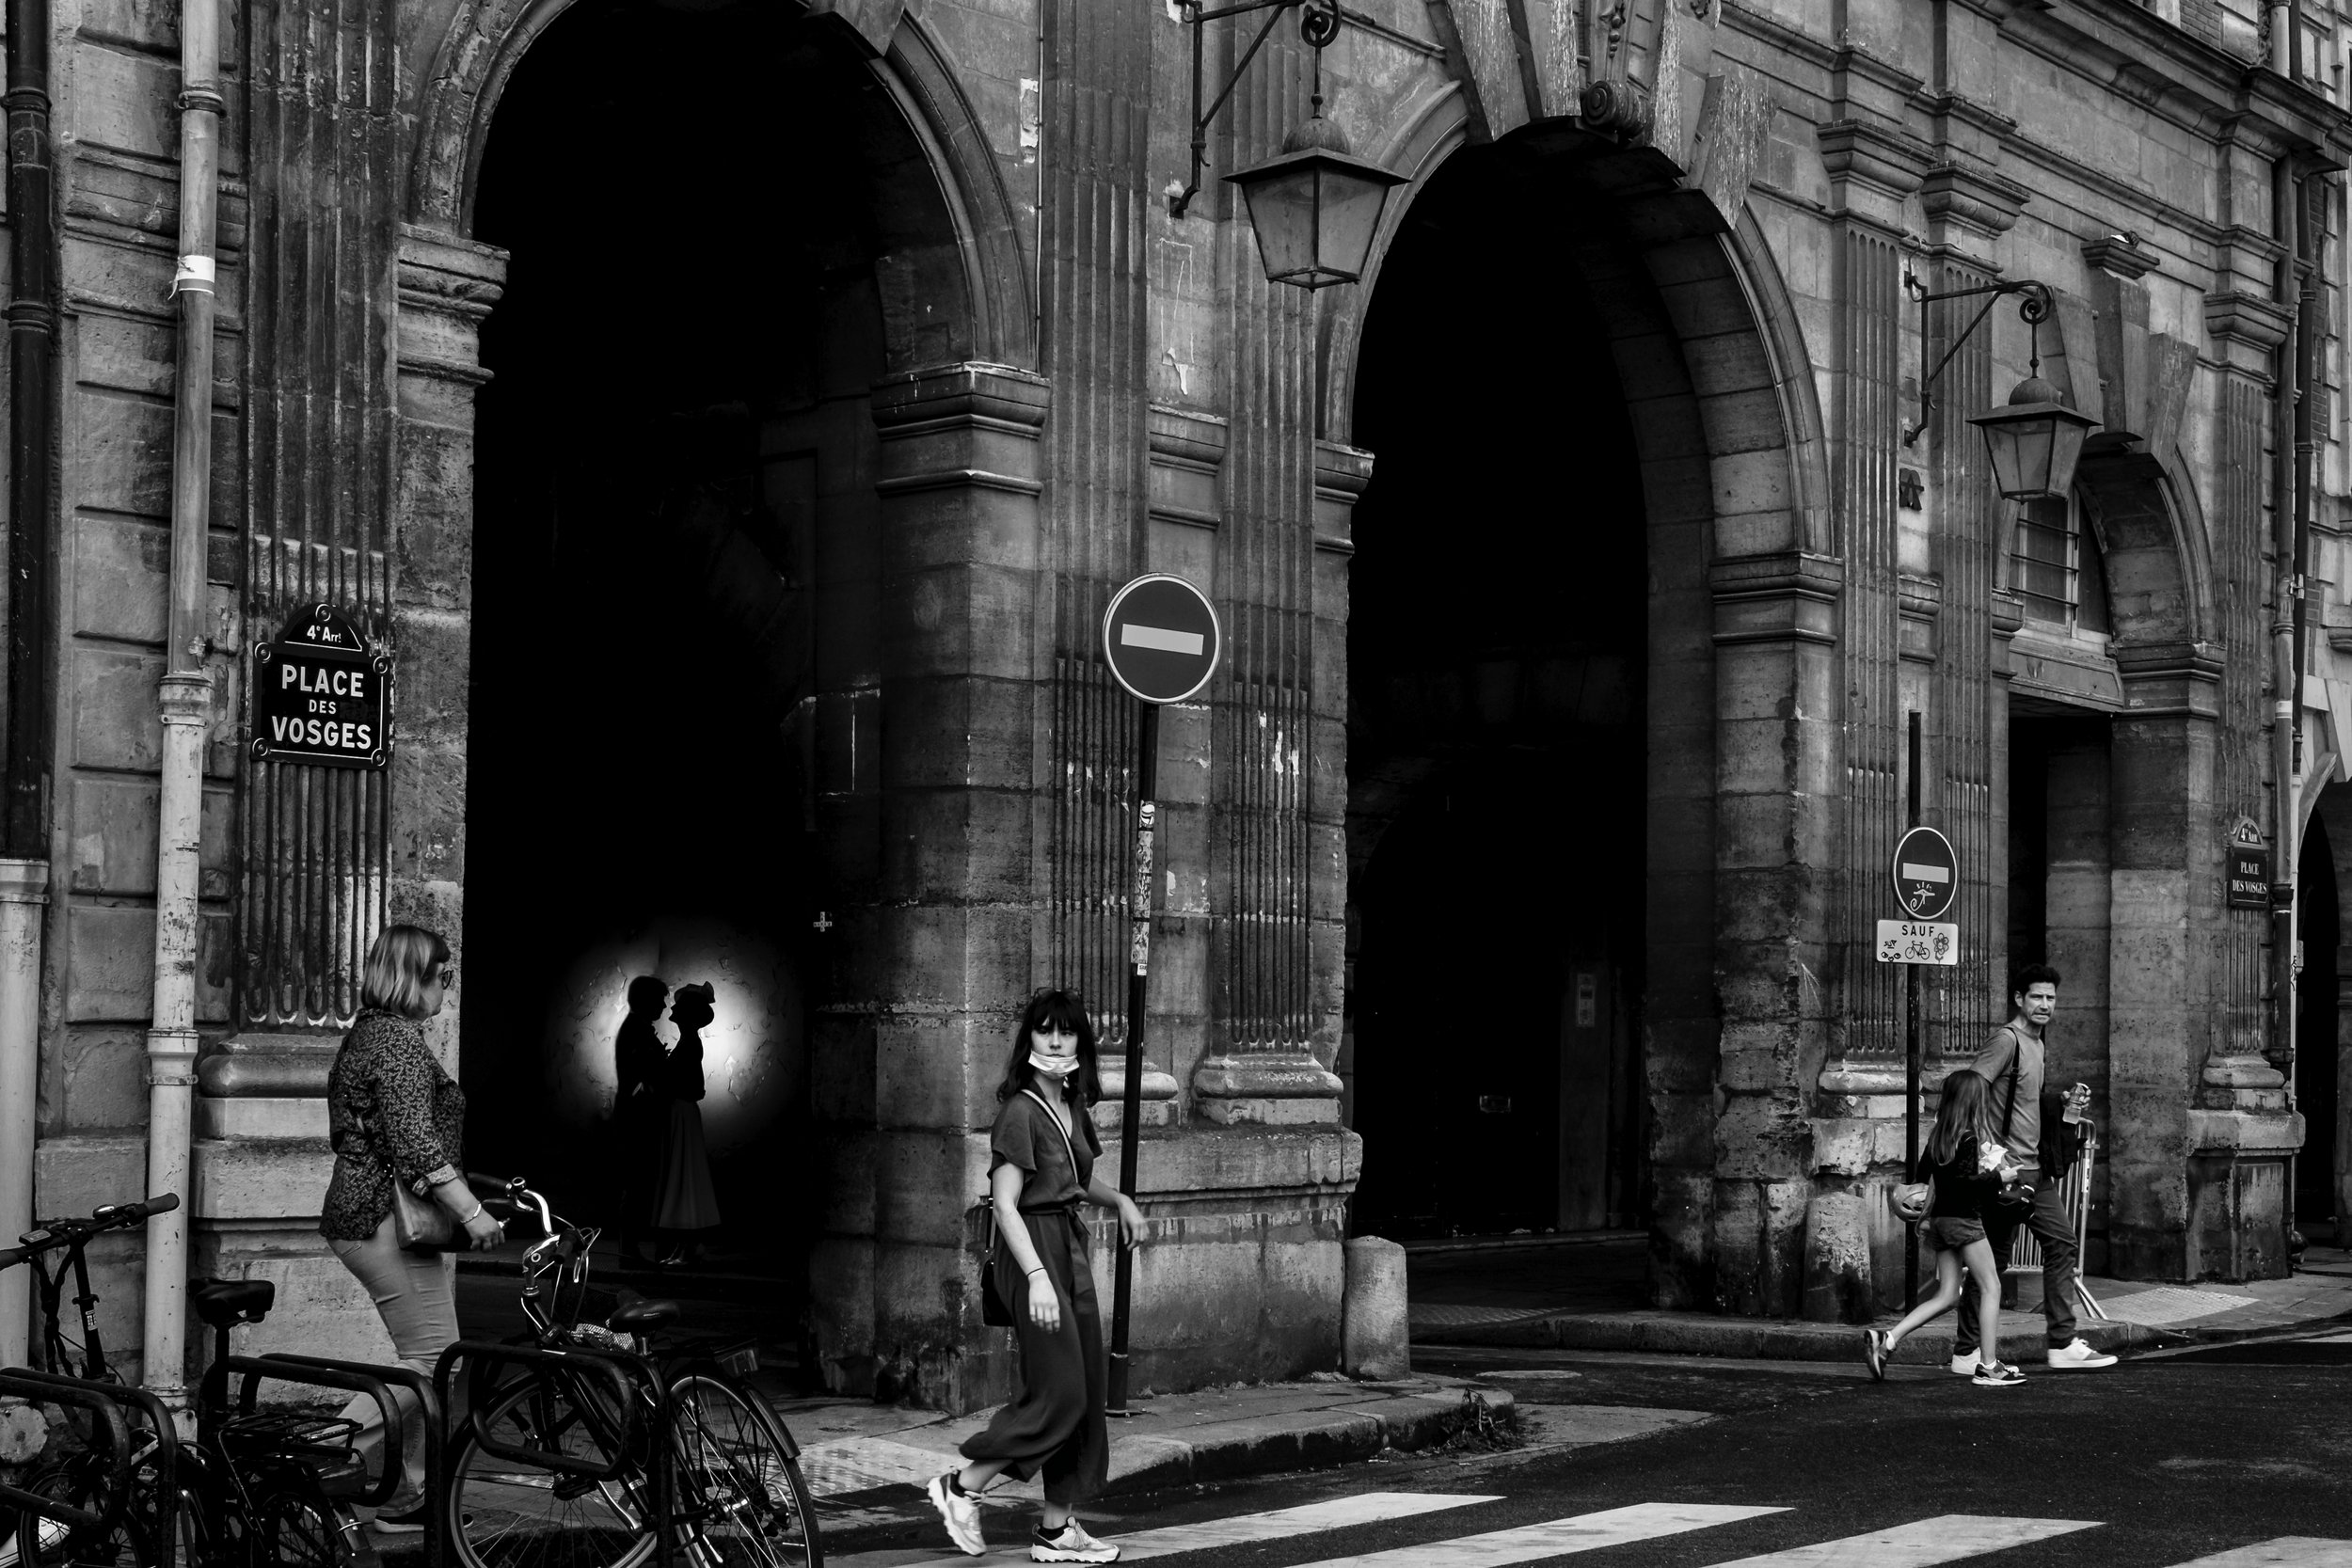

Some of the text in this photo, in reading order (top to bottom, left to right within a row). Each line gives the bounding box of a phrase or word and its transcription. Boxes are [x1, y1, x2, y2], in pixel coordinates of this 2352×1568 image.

[282, 664, 364, 698] PLACE
[309, 699, 337, 715] DES
[272, 716, 372, 750] VOSGES
[2241, 862, 2259, 875] PLACE
[2233, 879, 2266, 894] DES VOSGES
[1901, 925, 1935, 937] SAUF
